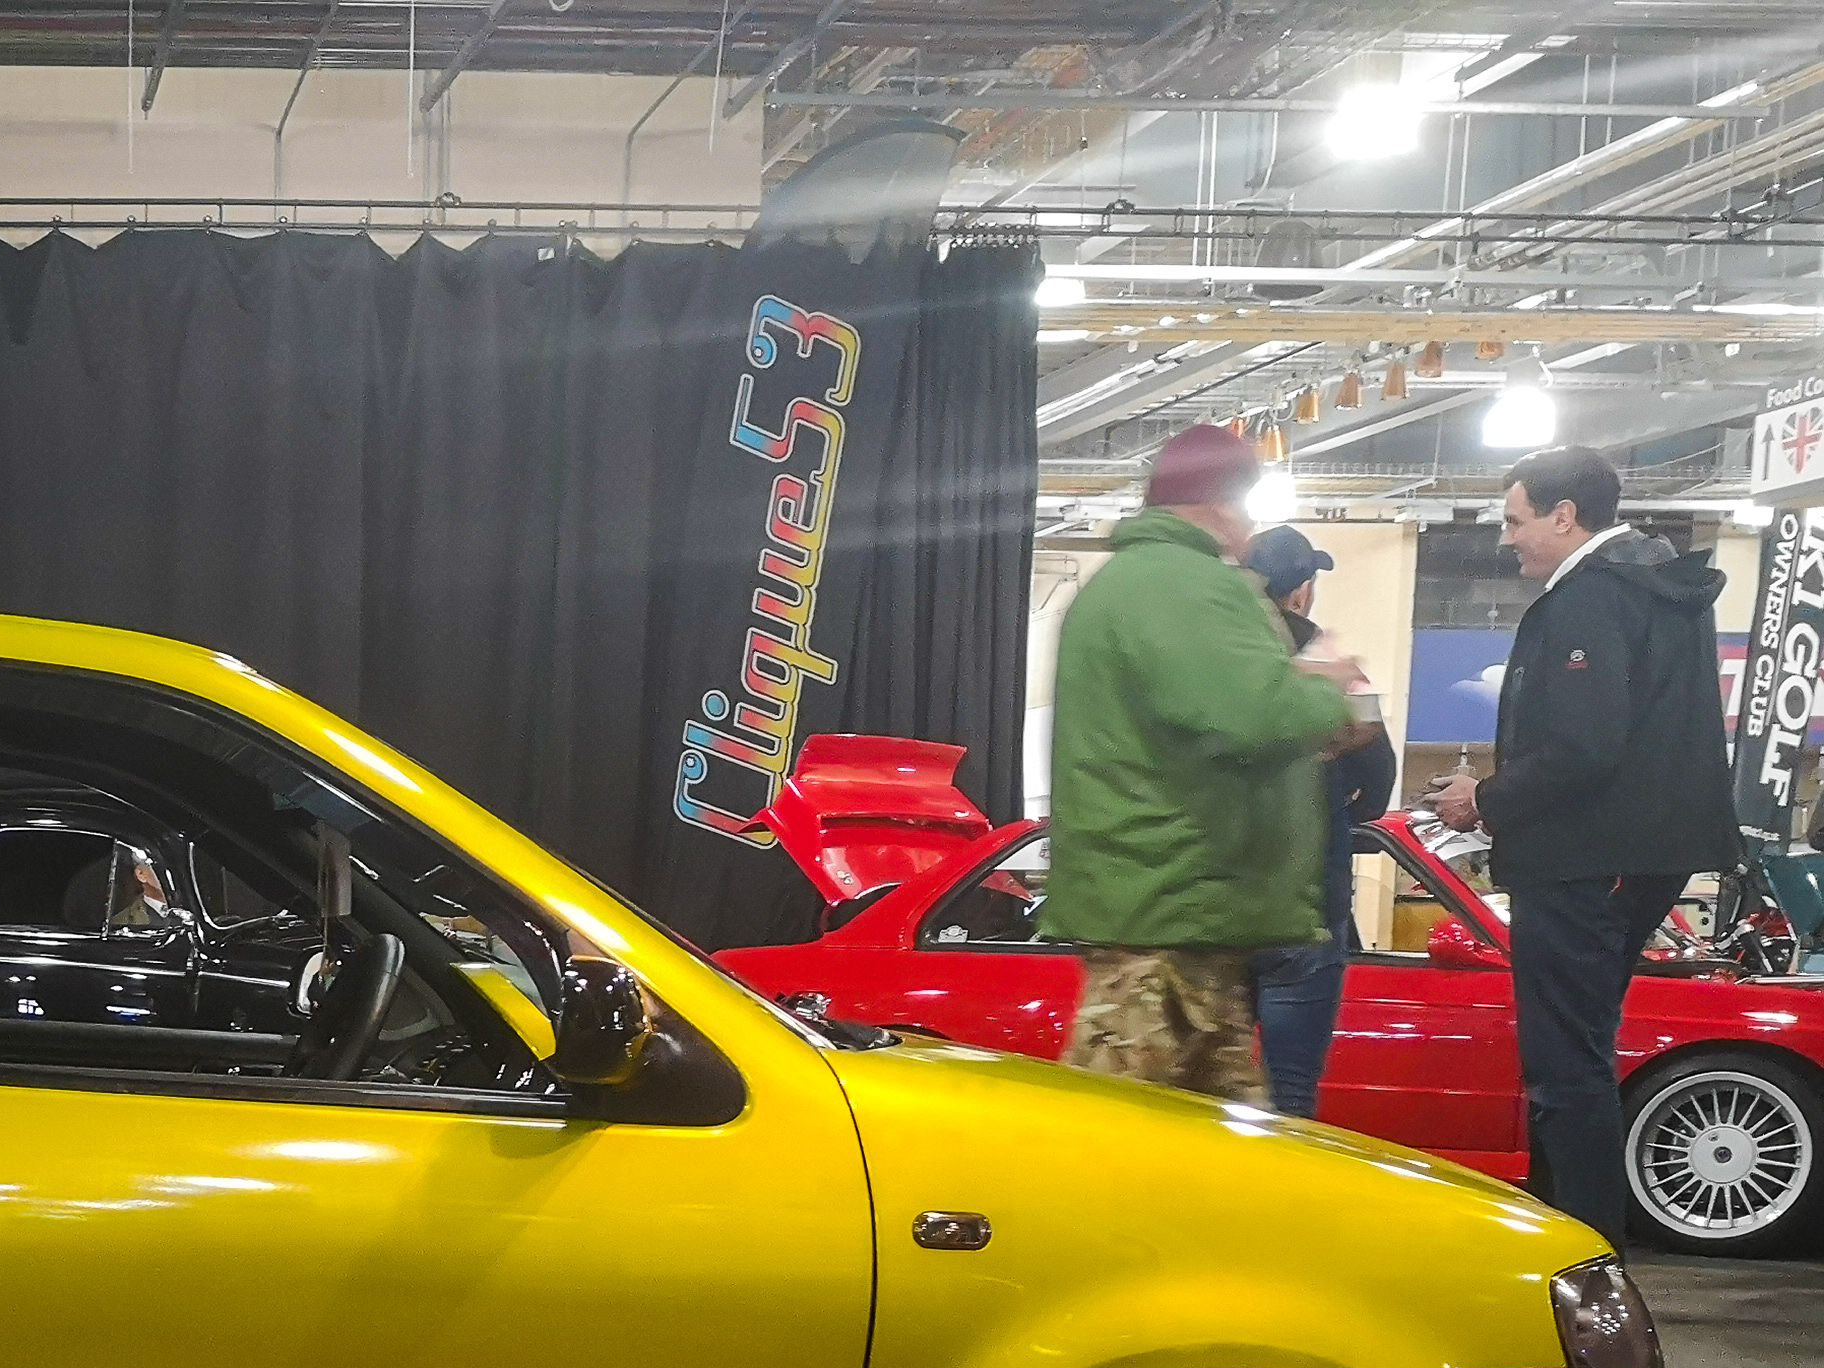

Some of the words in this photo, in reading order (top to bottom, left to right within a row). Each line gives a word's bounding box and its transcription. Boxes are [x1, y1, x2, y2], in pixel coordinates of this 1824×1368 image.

[1766, 379, 1802, 408] Food
[1760, 513, 1799, 649] OWNERS
[1747, 654, 1775, 736] CLUB
[1760, 621, 1820, 807] GOLF
